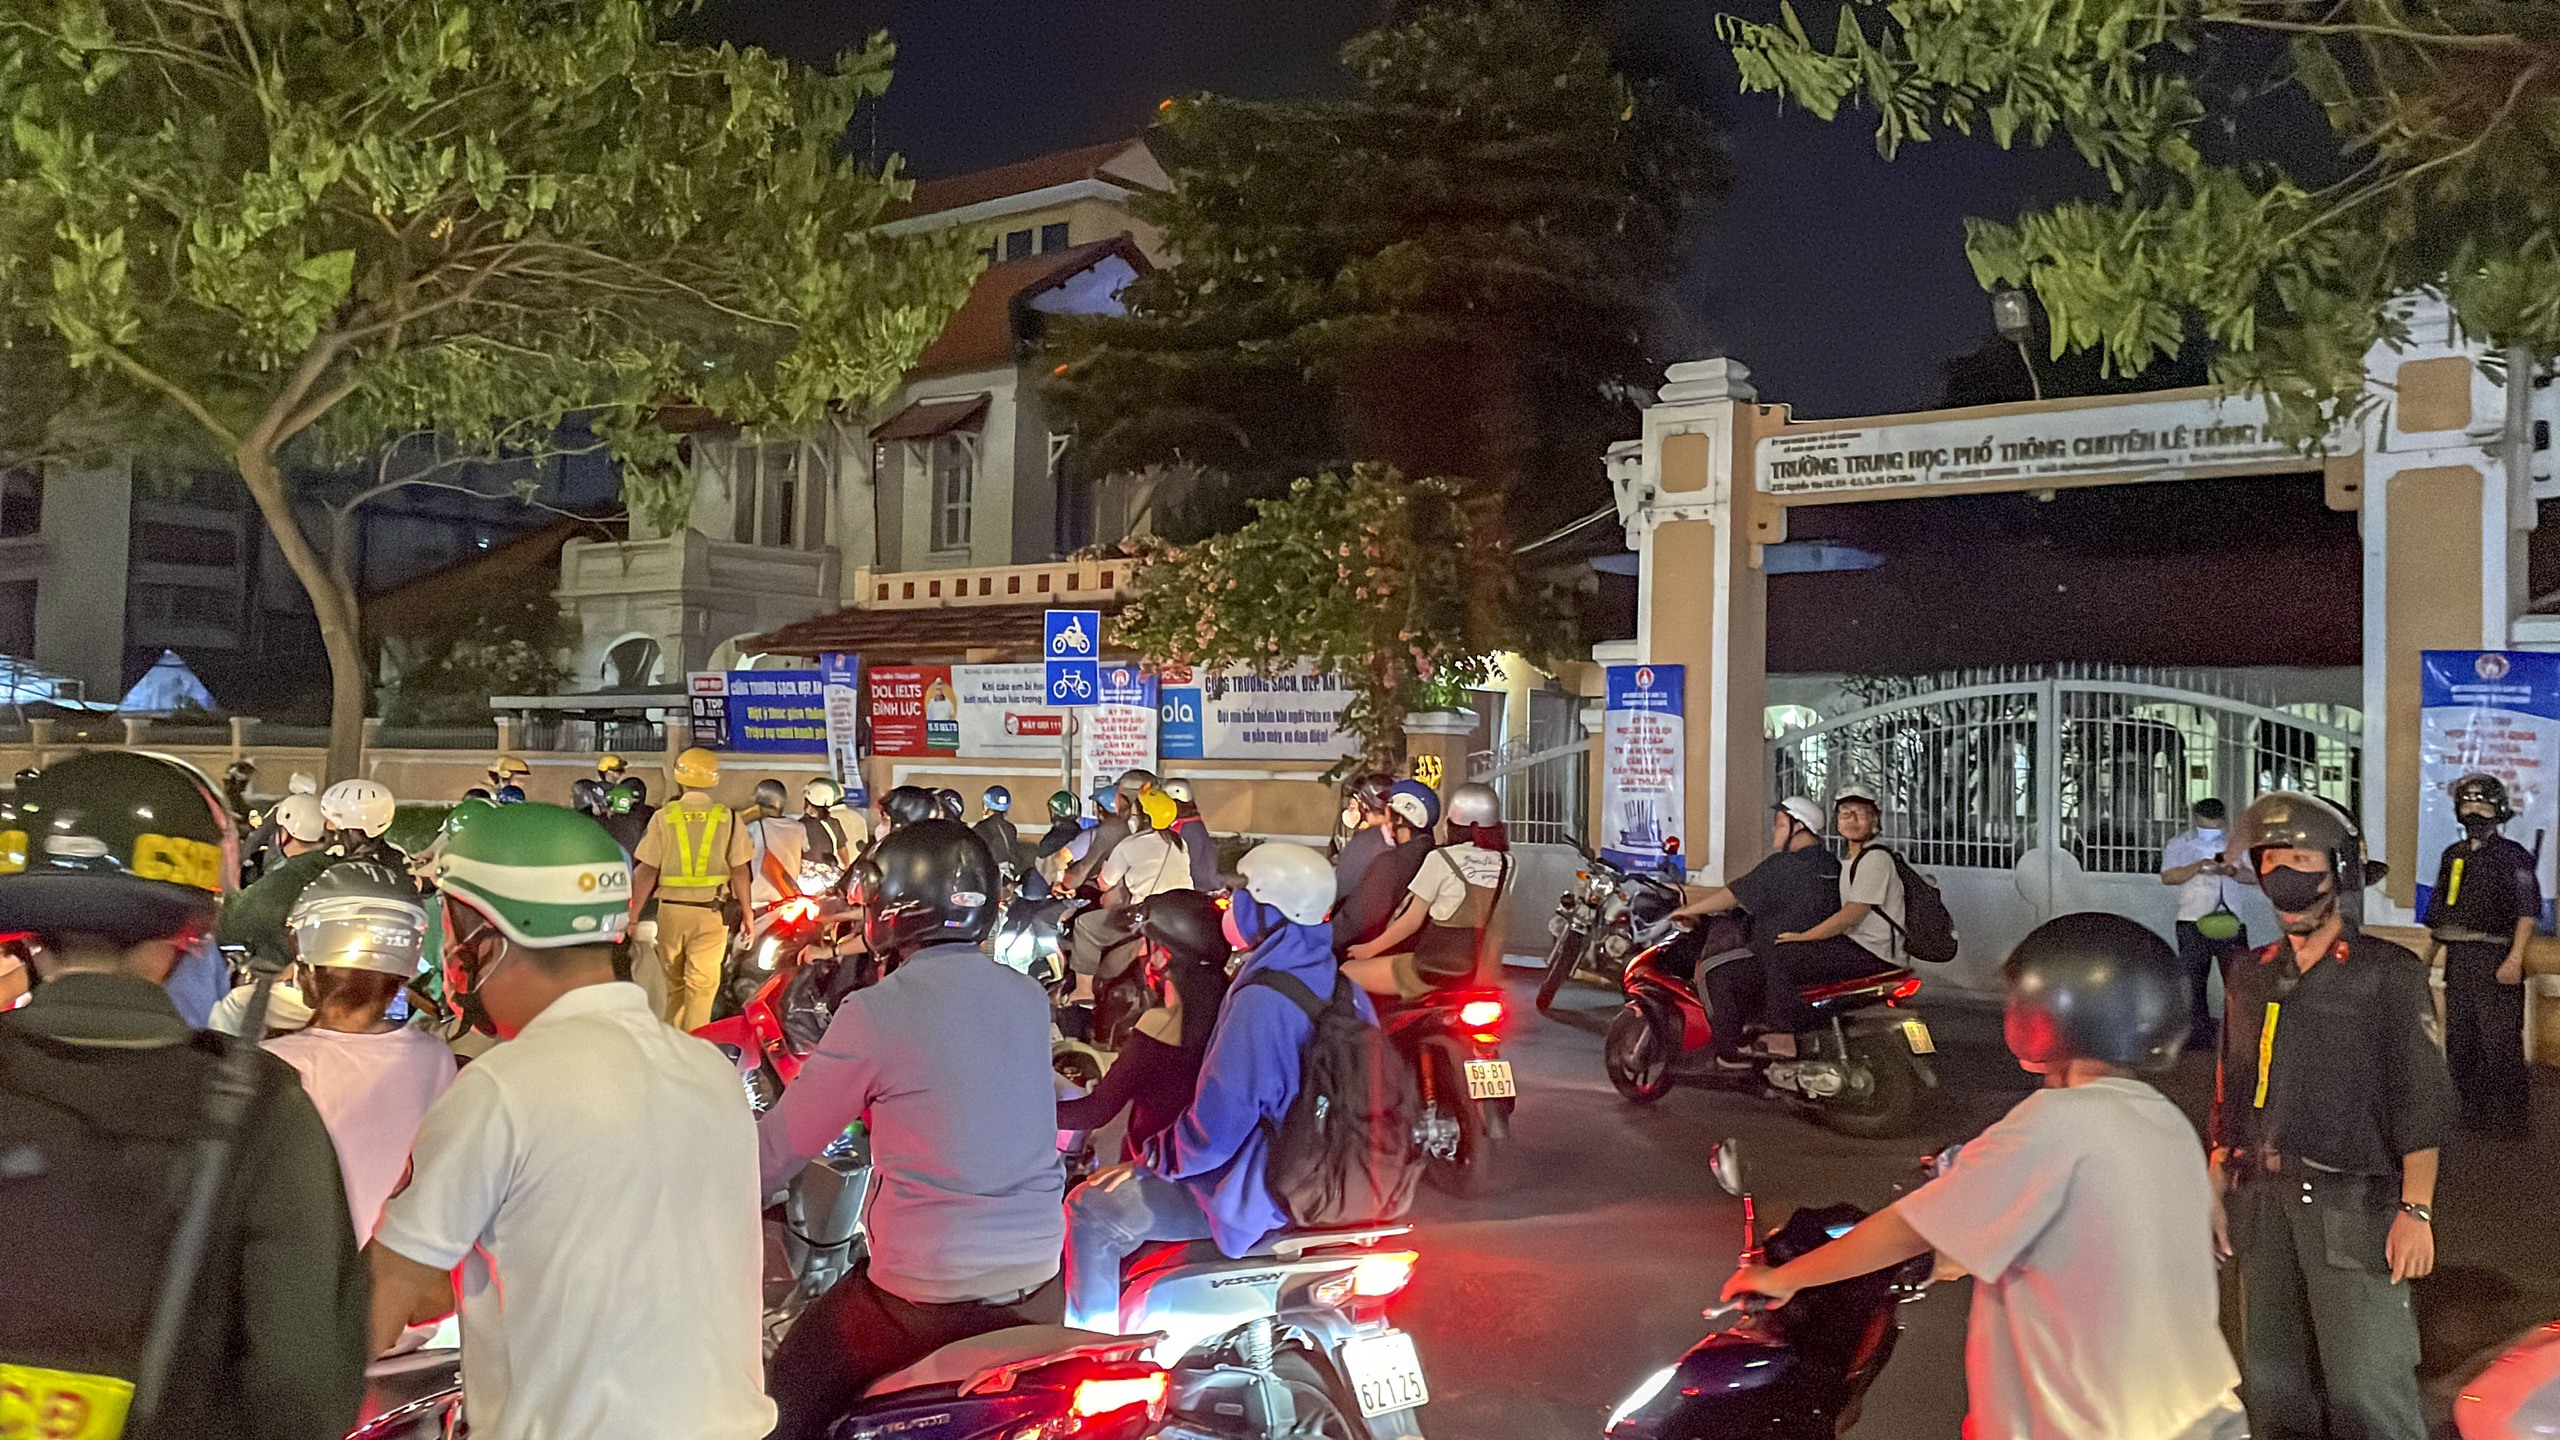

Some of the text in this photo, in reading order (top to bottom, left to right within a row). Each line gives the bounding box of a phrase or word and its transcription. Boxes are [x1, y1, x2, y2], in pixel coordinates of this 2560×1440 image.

[1844, 451, 1903, 474] TRUNG
[1908, 448, 1948, 471] HỌC
[1953, 434, 1994, 466] PHỔ
[1999, 436, 2067, 462] THÔNG
[2072, 428, 2156, 457] CHUYÊN
[871, 684, 922, 698] DOL IELTS
[1161, 695, 1194, 723] ola
[1470, 1080, 1512, 1097] 710.97
[1360, 1371, 1422, 1411] 621.25
